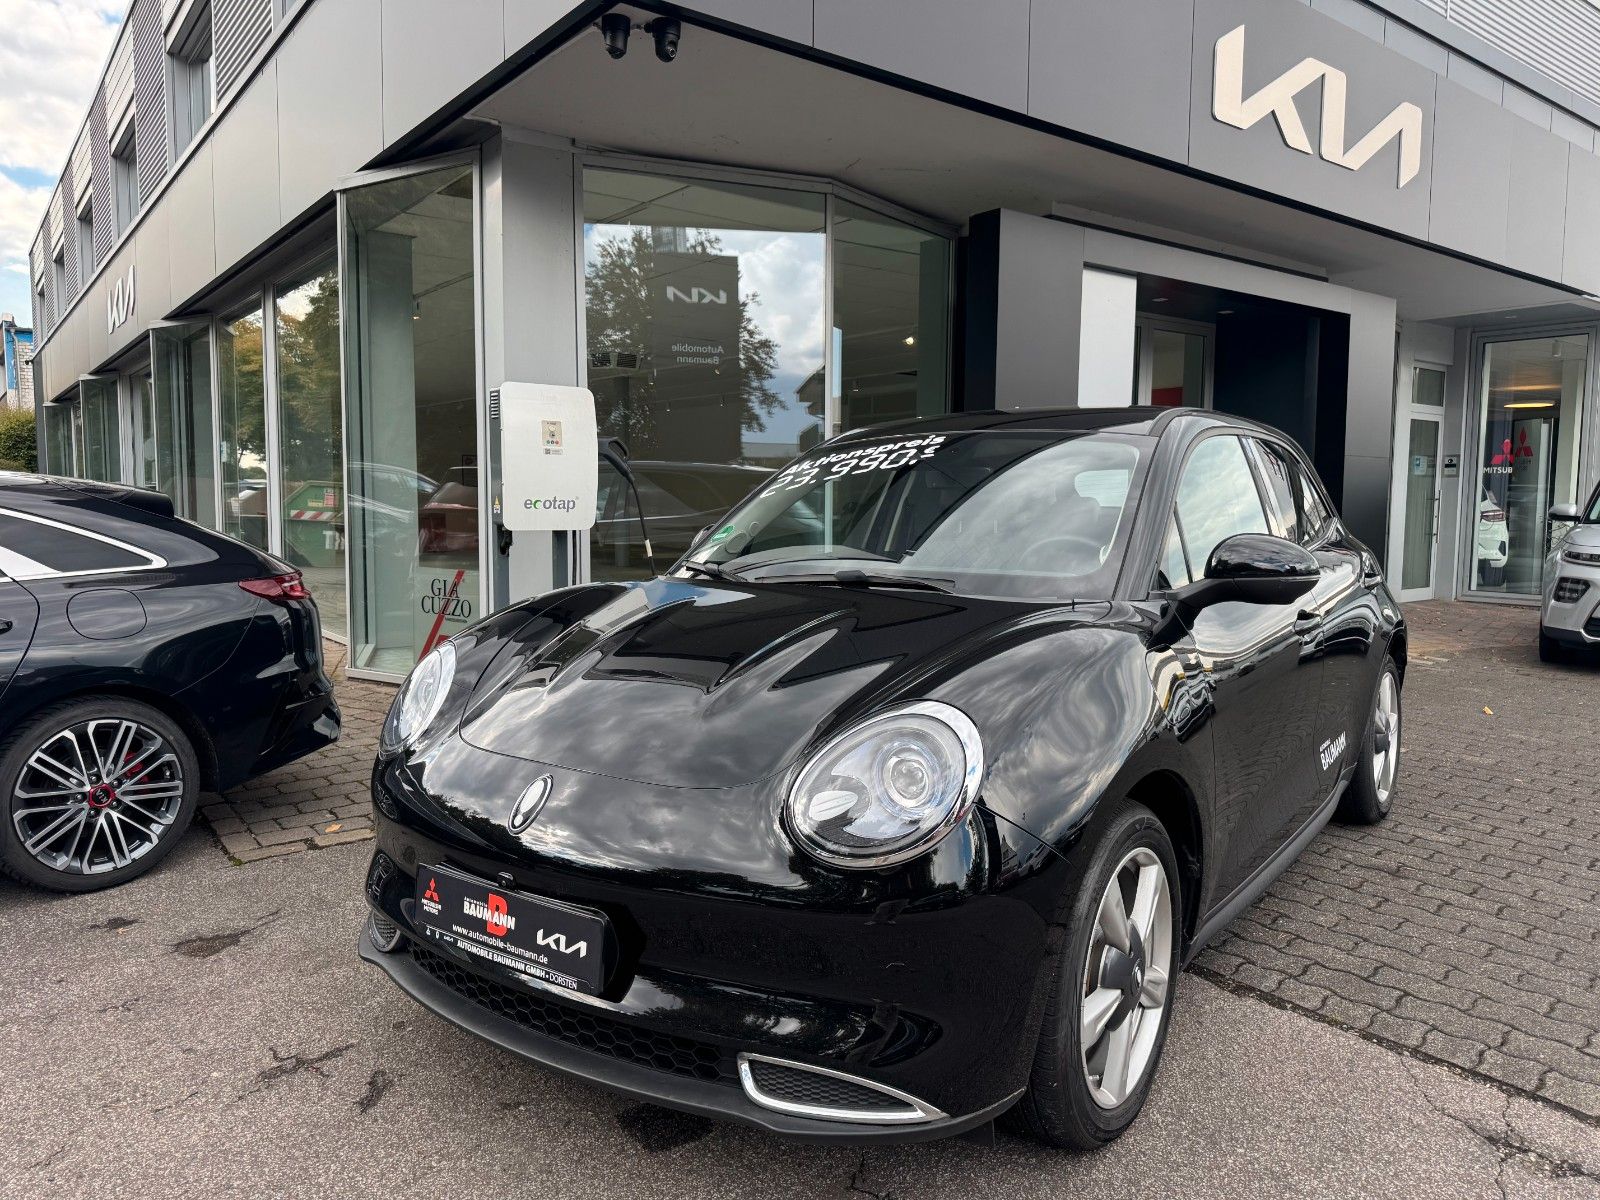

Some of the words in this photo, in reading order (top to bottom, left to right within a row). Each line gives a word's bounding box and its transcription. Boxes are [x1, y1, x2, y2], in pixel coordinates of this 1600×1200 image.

[1212, 24, 1423, 189] KIA
[107, 264, 136, 335] KIA
[777, 434, 947, 479] Aktionspreis
[523, 495, 577, 513] ecotap
[420, 595, 472, 619] CUZZO
[463, 900, 516, 931] BAUMANN
[452, 923, 548, 965] www.automobile-baumann.de
[456, 939, 493, 961] AUTOMOBILE
[493, 952, 526, 972] BAUMANN
[525, 964, 546, 979] GMBH
[549, 972, 578, 990] DORSTEN
[536, 928, 587, 959] KIA
